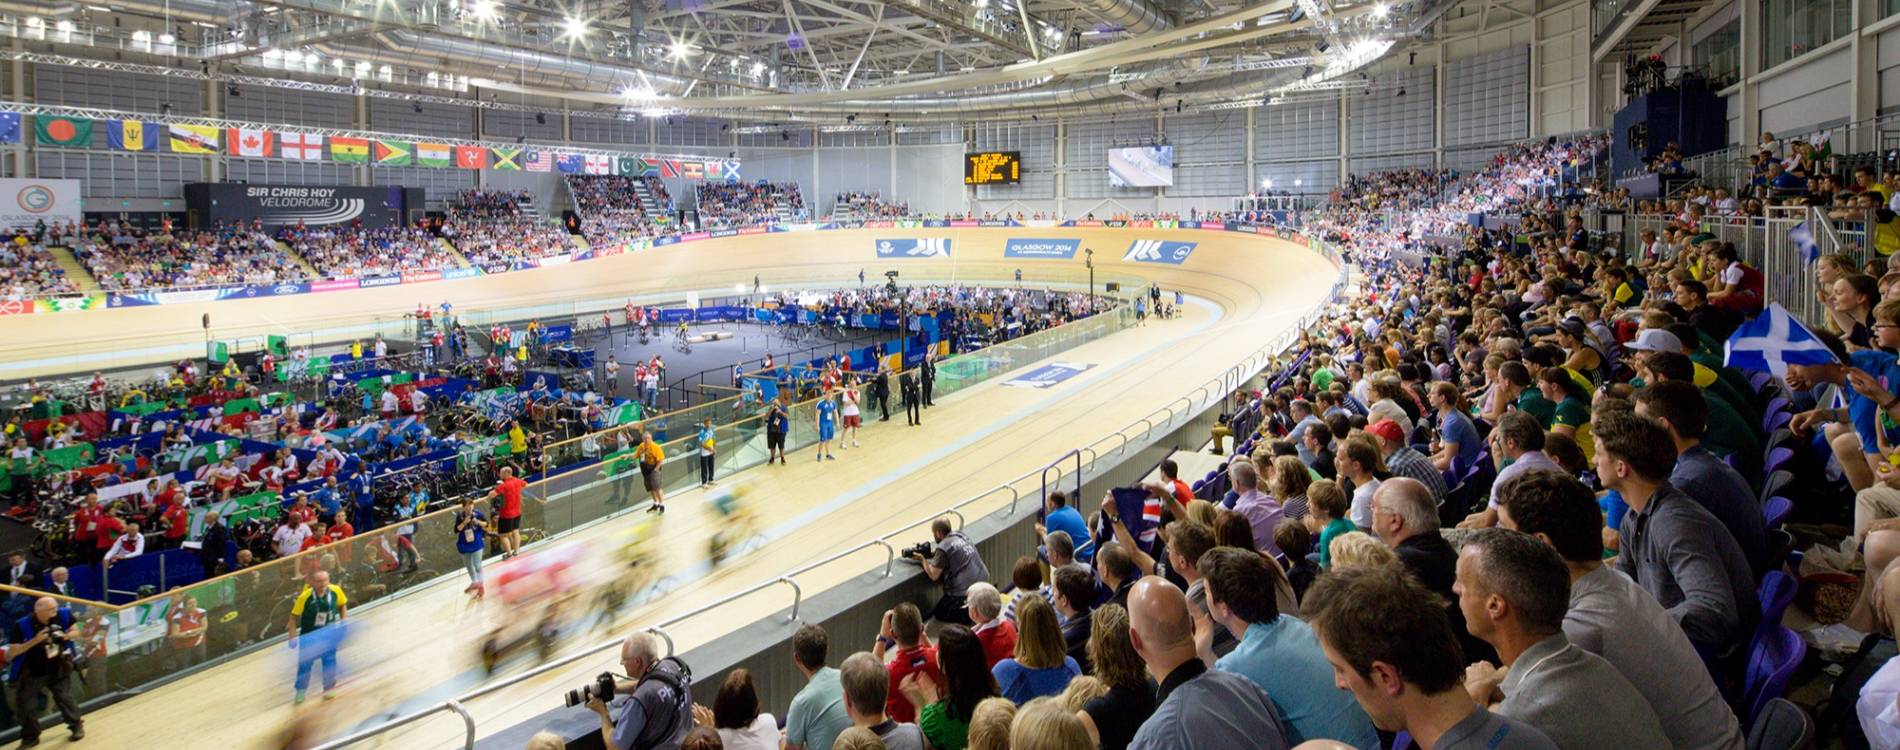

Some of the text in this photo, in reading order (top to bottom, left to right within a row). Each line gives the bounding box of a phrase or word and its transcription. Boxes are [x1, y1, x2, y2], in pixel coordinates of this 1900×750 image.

[247, 187, 336, 198] SIR CHRIS HOY
[259, 197, 332, 208] VELODROME
[1011, 244, 1072, 252] GLASGOW 2014
